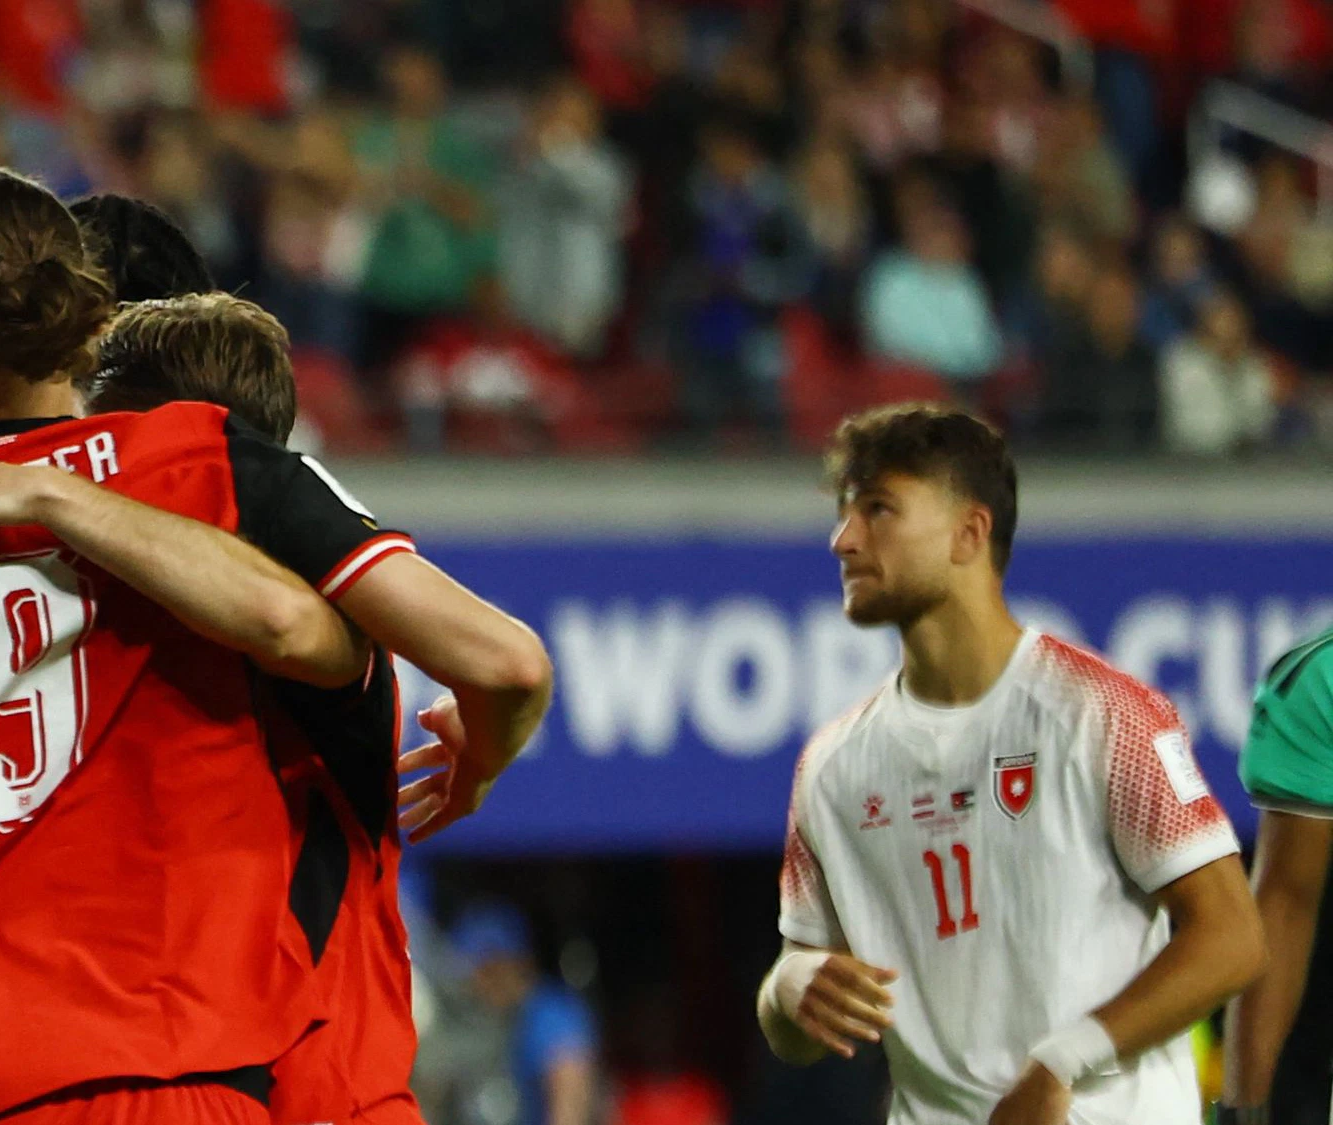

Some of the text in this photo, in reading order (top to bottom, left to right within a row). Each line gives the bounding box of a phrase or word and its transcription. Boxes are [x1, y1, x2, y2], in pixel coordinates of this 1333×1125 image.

[548, 595, 1090, 757] WOR
[1105, 595, 1333, 750] CU
[922, 842, 980, 942] 11
